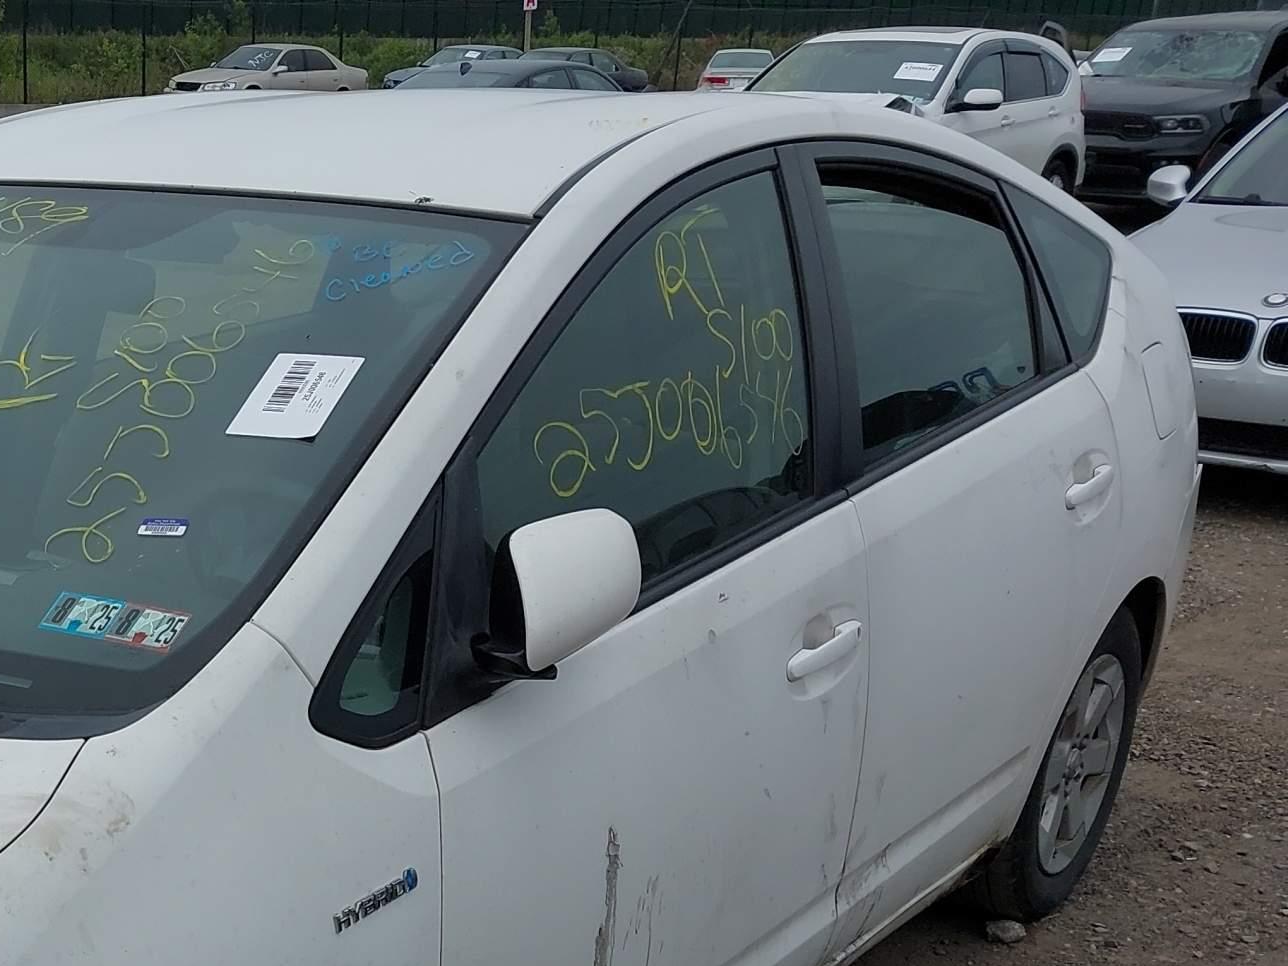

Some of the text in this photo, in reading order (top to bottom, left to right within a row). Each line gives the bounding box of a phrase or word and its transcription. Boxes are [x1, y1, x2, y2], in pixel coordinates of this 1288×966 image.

[706, 304, 793, 384] S100
[89, 604, 118, 631] 25
[154, 616, 184, 644] 25
[333, 878, 407, 934] HYBRID
